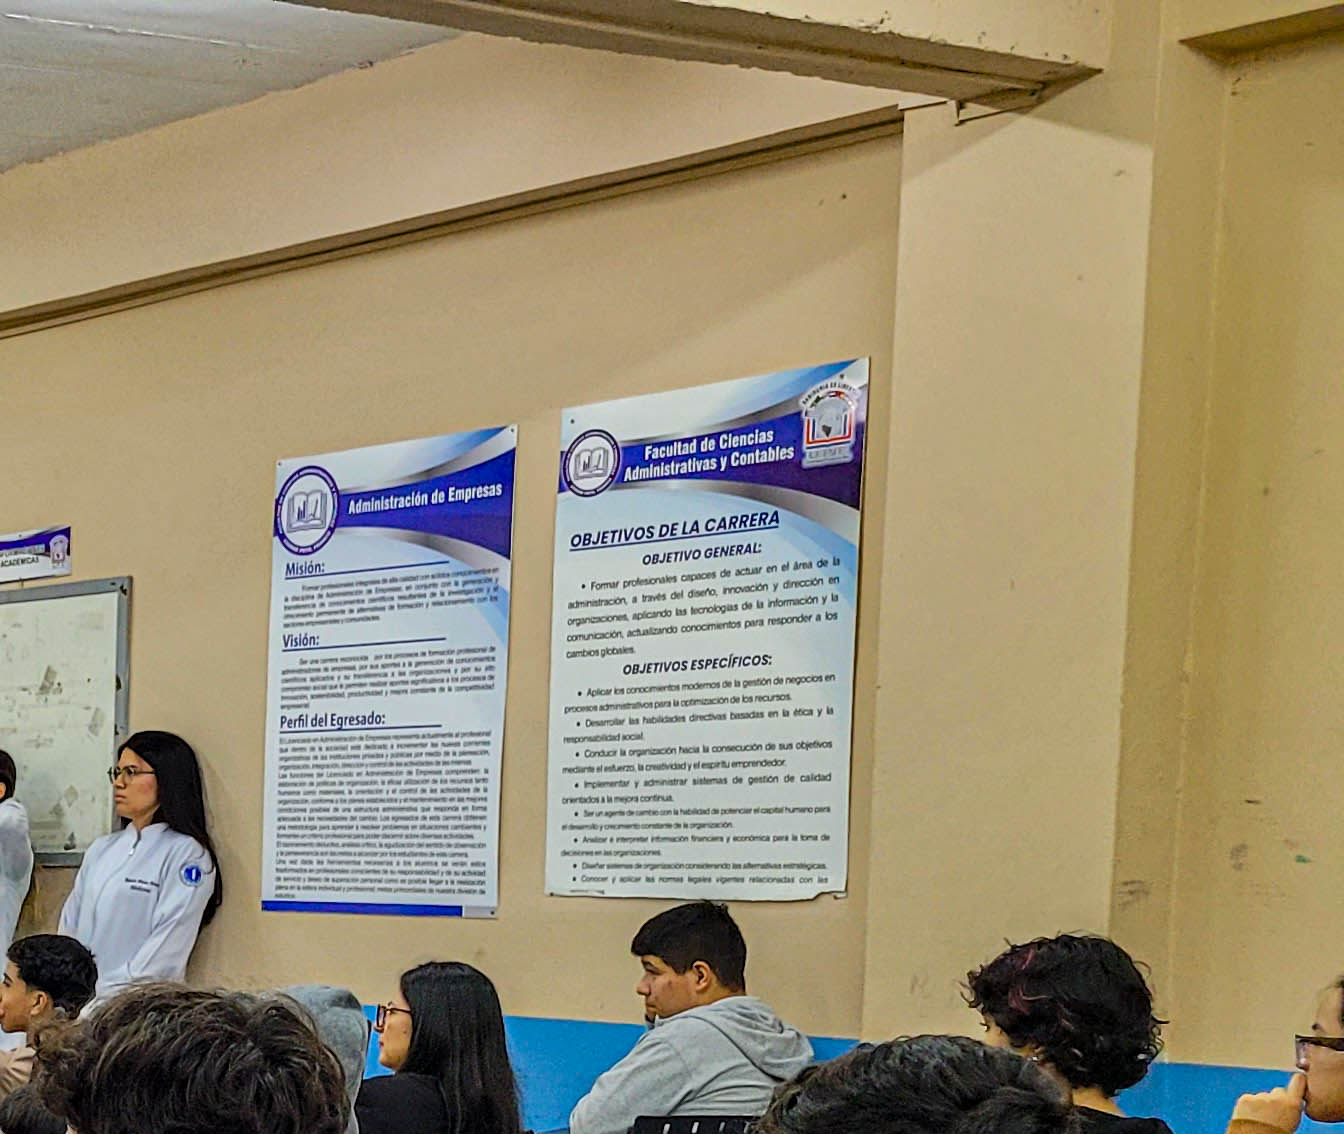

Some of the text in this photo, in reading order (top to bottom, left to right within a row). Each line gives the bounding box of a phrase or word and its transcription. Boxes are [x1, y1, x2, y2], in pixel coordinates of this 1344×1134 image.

[644, 429, 774, 461] Facultad de Ciencias
[624, 458, 717, 482] Administrativas
[719, 458, 728, 472] y
[730, 446, 795, 467] Contables
[348, 483, 503, 515] Administración de Empresas
[570, 510, 780, 548] OBJETIVOS DE LA CARRERA
[642, 543, 762, 566] OBJETIVO GENERAL:
[285, 561, 325, 577] Misión:
[590, 579, 619, 590] Formar
[622, 573, 678, 589] profesionales
[680, 571, 717, 583] capaces
[719, 568, 731, 577] de
[734, 565, 762, 576] actuar
[765, 565, 778, 573] en
[780, 562, 790, 571] el
[815, 558, 828, 568] de
[832, 557, 840, 566] la
[282, 633, 320, 648] Visión:
[622, 653, 773, 676] OBJETIVOS ESPECÍFICOS:
[280, 710, 386, 731] Perfil del Egresado:
